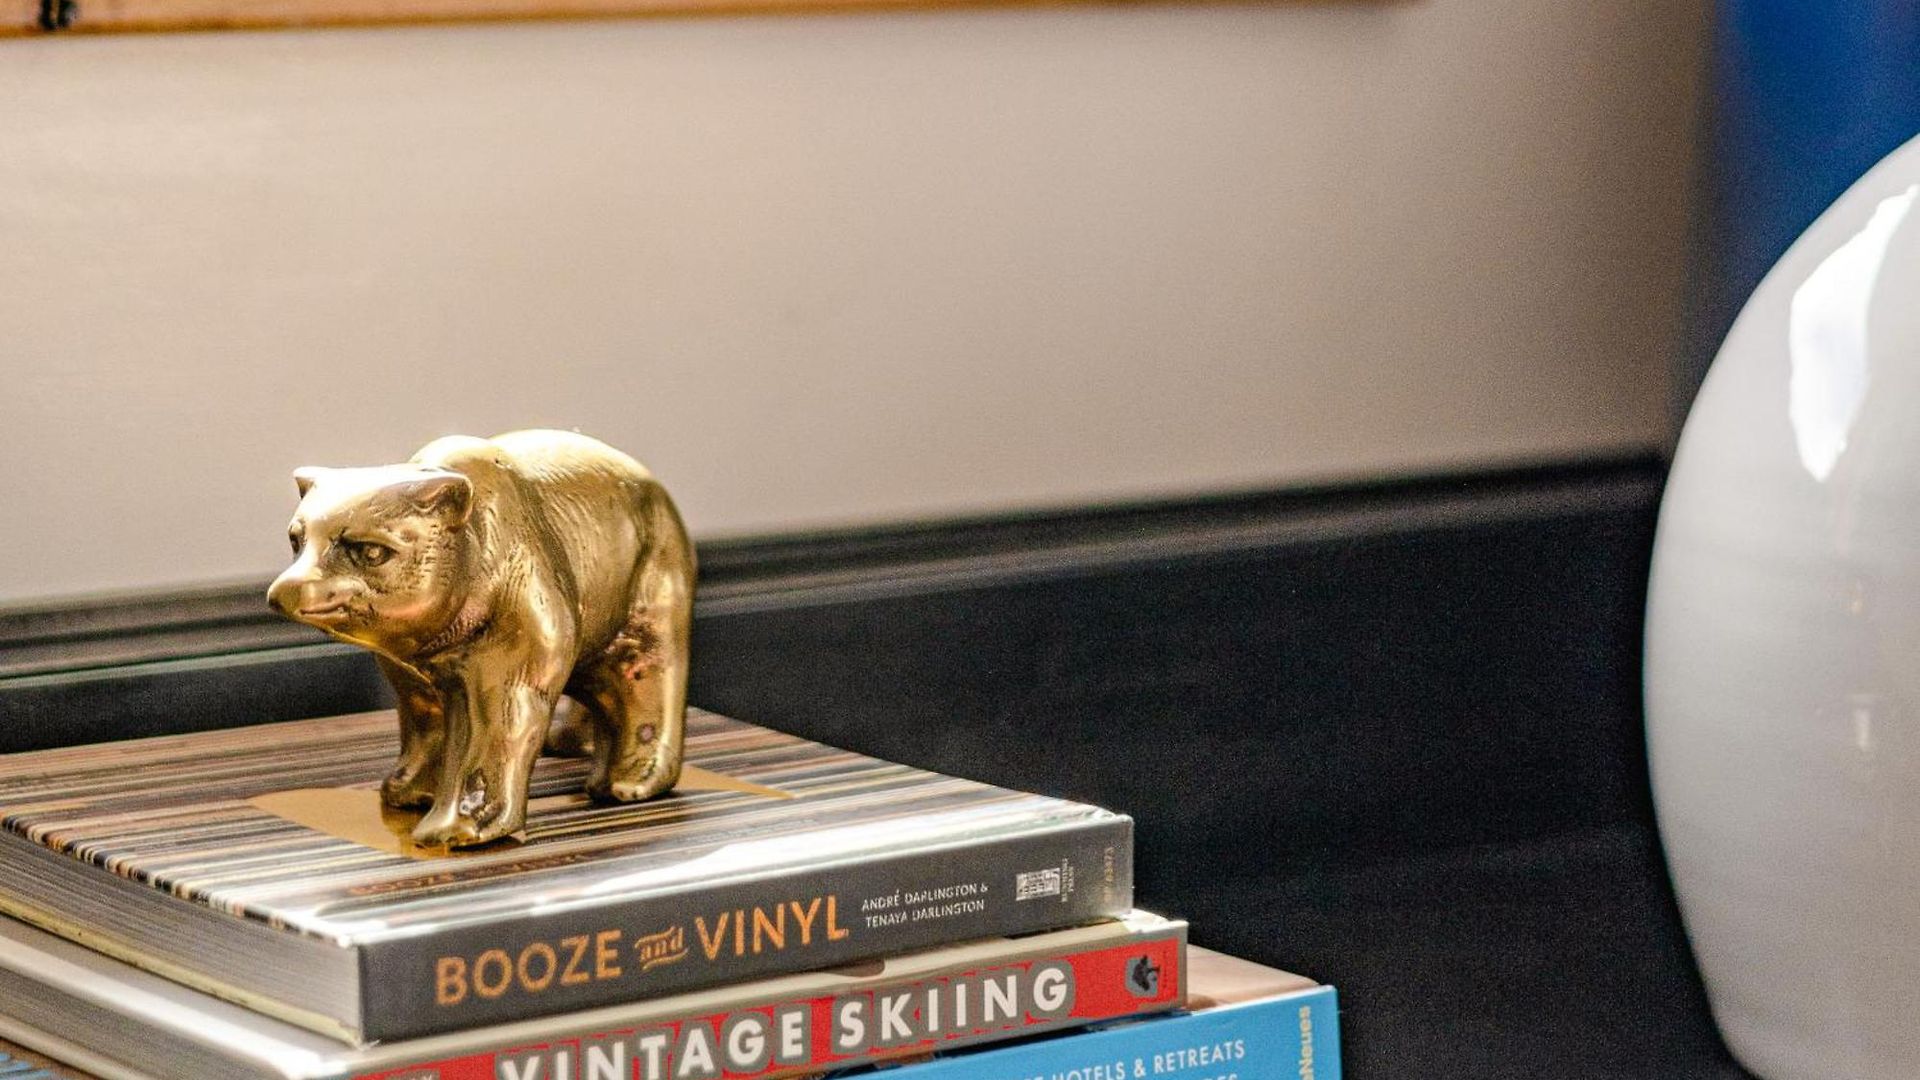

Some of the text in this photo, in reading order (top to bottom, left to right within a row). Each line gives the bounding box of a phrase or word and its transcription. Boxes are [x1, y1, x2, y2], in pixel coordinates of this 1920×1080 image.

[862, 883, 989, 912] ANDRÉ DARLINGTON &
[866, 899, 985, 928] TENAYA DARLINGTON
[435, 896, 849, 1005] BOOZE and VINYL
[838, 967, 1068, 1048] SKIING
[1133, 1058, 1147, 1079] &
[1153, 1039, 1246, 1074] RETREATS
